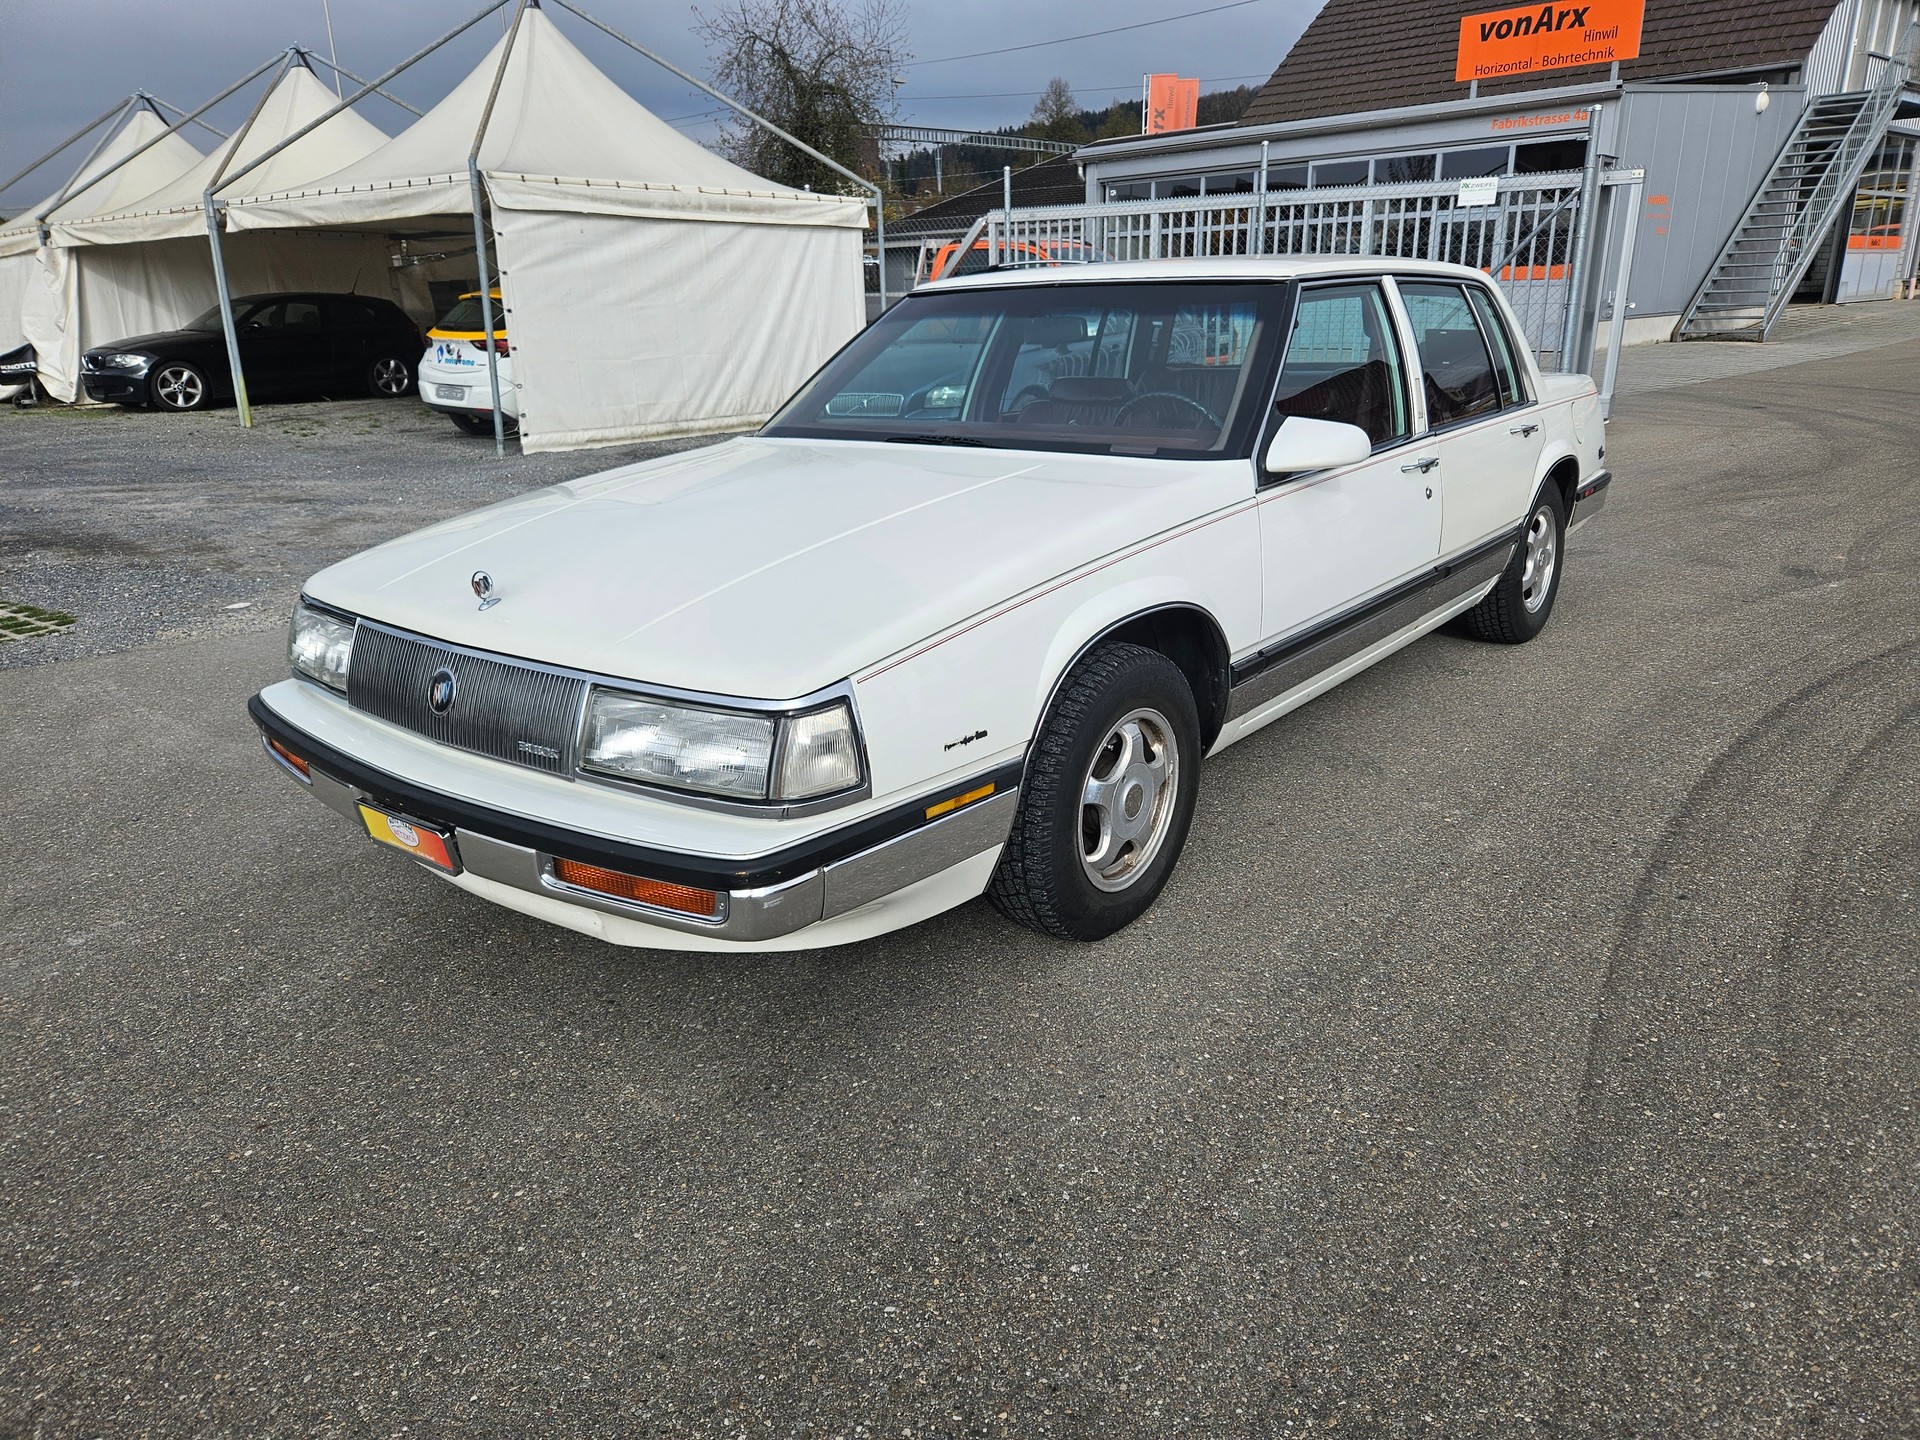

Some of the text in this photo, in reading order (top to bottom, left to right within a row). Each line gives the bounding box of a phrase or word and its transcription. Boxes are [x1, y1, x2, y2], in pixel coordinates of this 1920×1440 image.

[1480, 6, 1591, 43] vonArx
[1583, 25, 1619, 43] Hinwil
[1475, 57, 1533, 76] Horizontal
[1542, 47, 1615, 67] Bohrtechnik
[1491, 109, 1589, 130] Fabrikstrasse 4a
